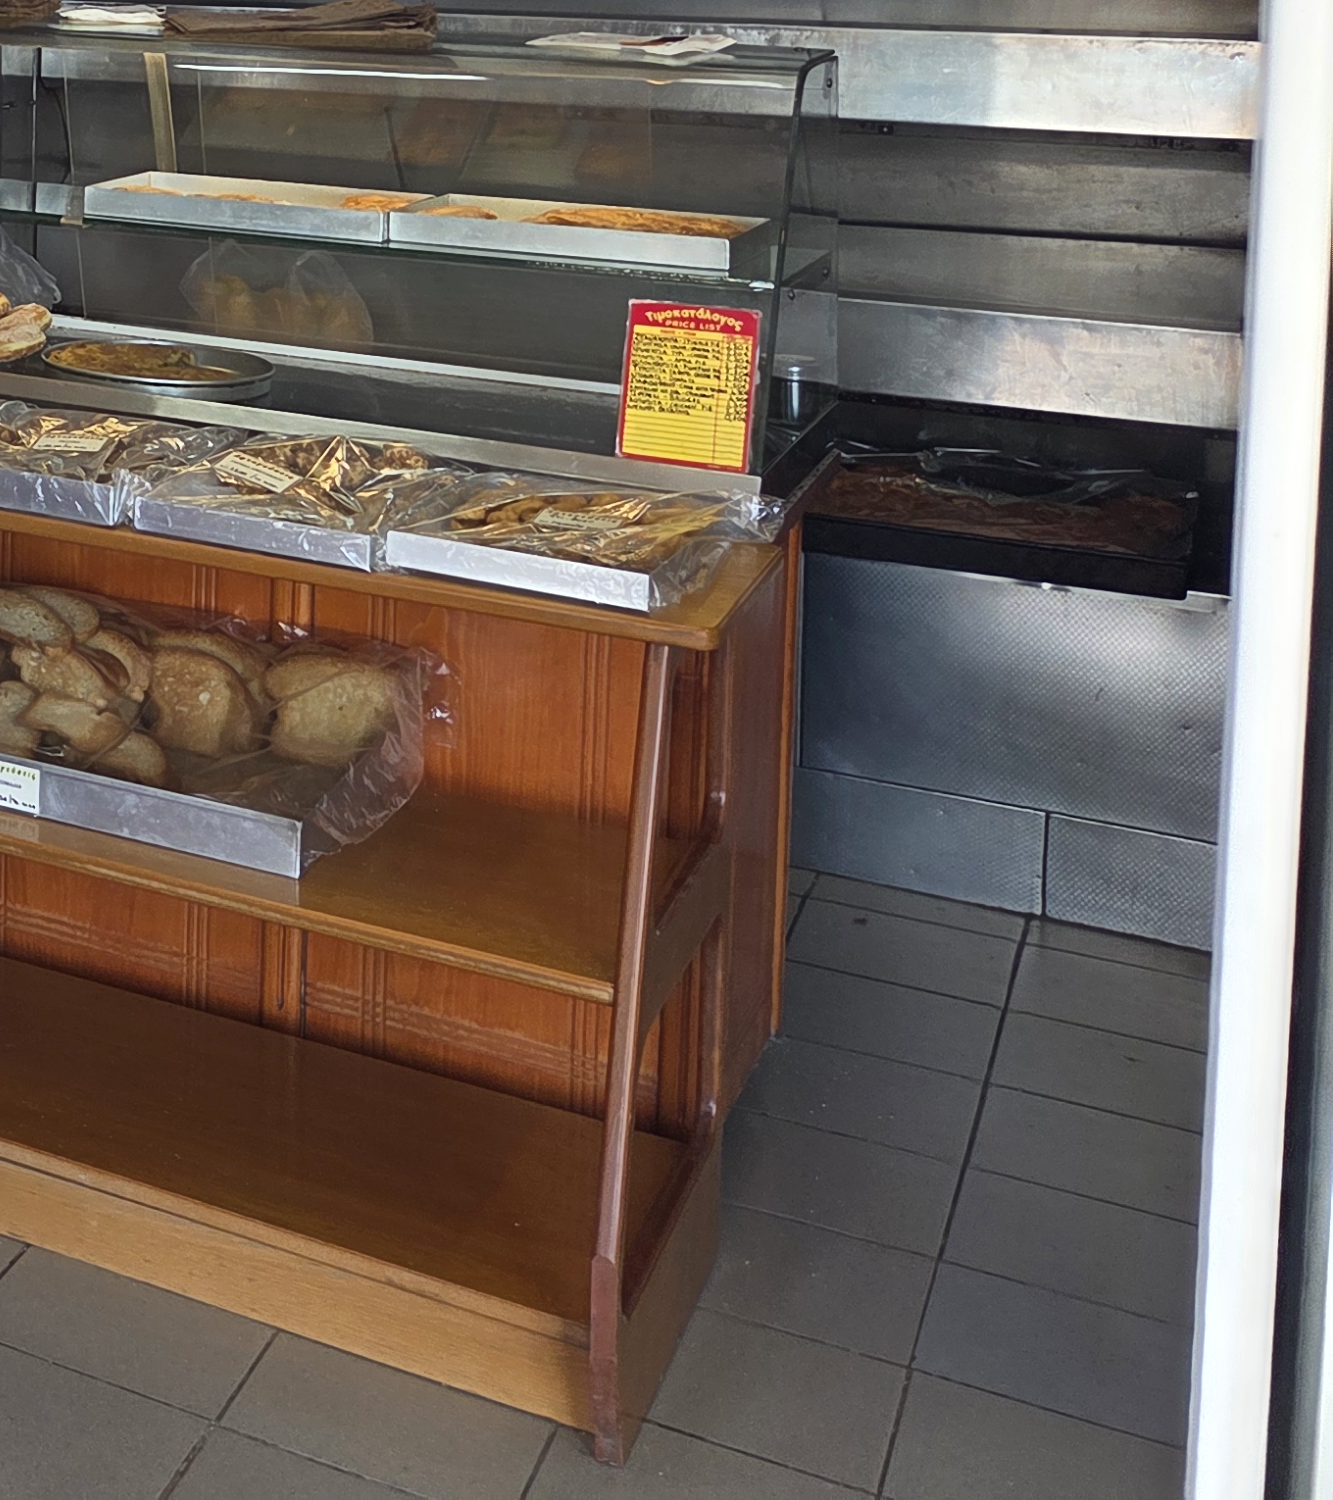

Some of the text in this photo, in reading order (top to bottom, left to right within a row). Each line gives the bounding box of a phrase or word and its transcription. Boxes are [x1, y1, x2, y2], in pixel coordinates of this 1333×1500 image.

[645, 308, 744, 332] Τιμοκατάλογος
[665, 319, 722, 332] PRICE LIST
